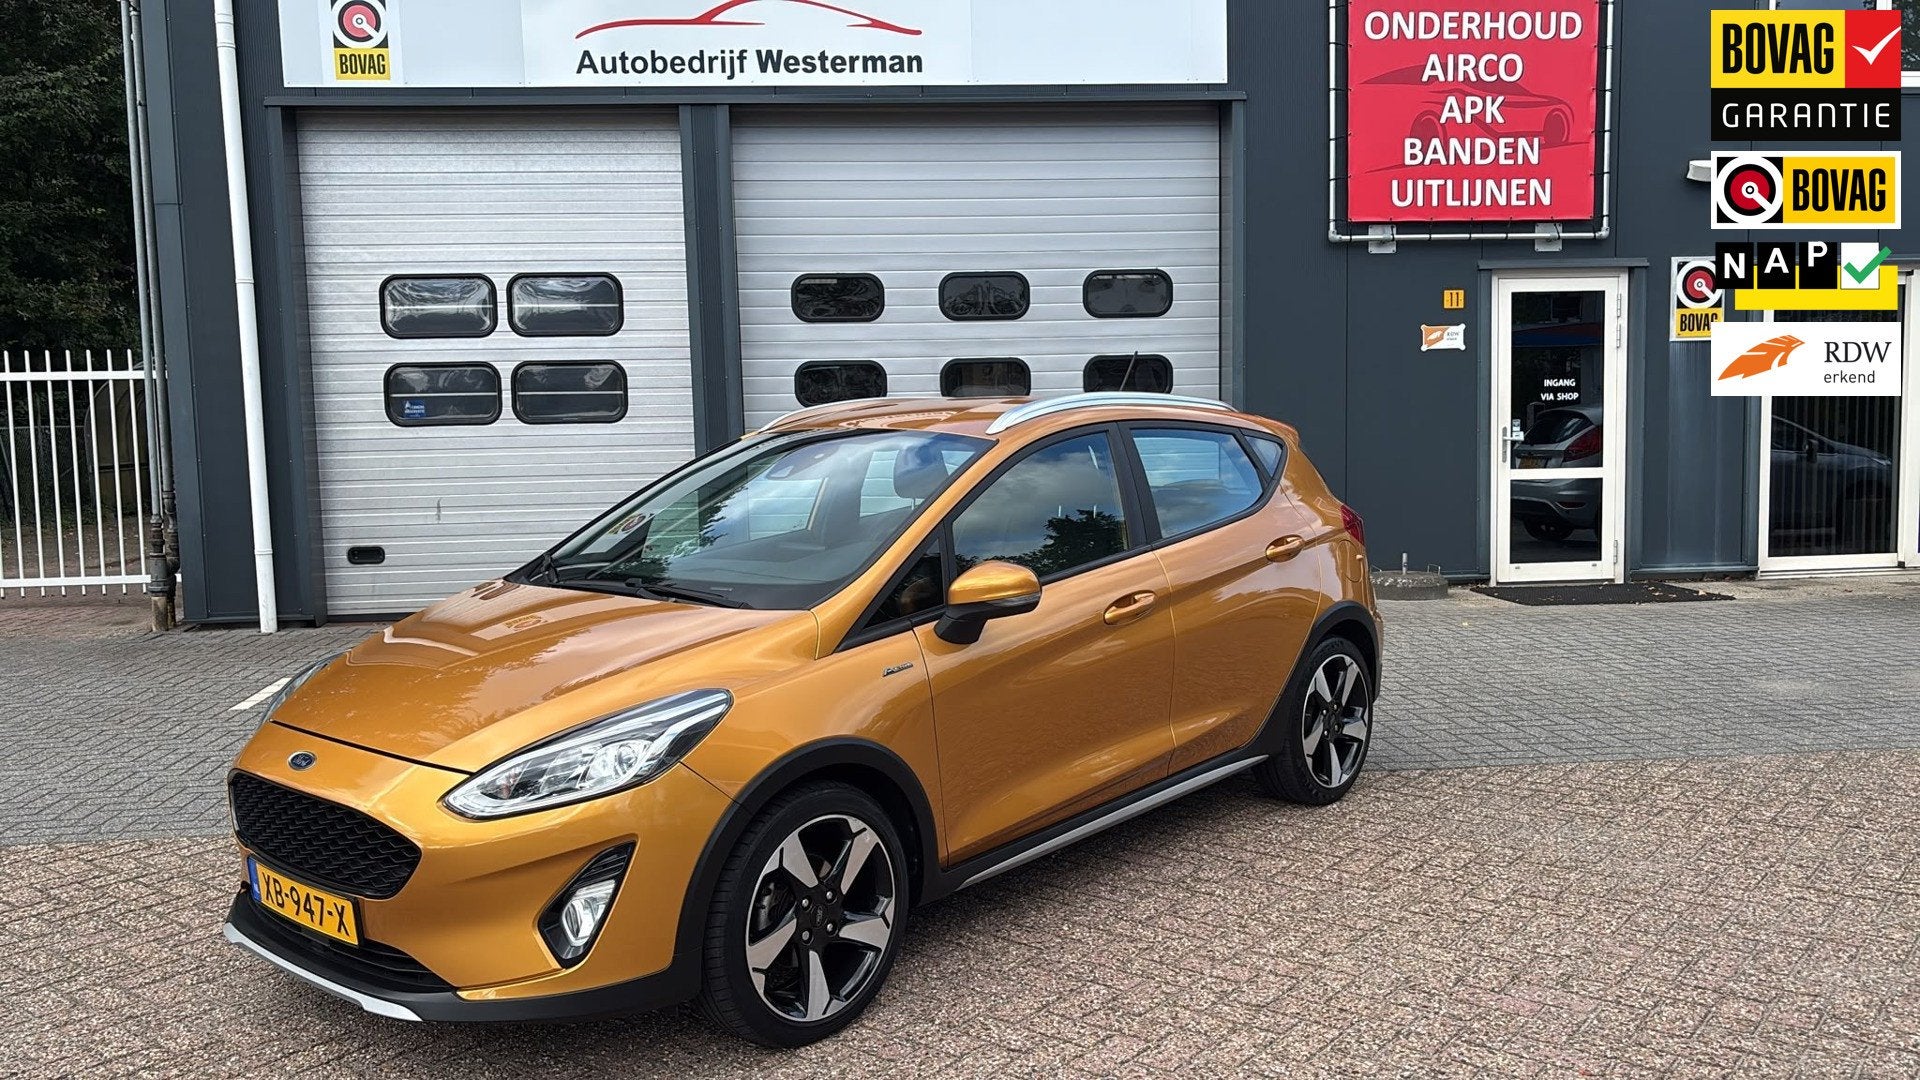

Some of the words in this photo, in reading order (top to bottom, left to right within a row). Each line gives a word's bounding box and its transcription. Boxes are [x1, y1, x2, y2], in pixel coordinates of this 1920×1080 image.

[1364, 11, 1583, 40] ONDERHOUD
[339, 53, 386, 75] BOVAG
[576, 49, 748, 80] Autobedrijf
[756, 49, 923, 74] Westerman
[1421, 53, 1524, 82] AIRCO
[1439, 96, 1505, 124] APK
[1404, 137, 1540, 165] BANDEN
[1391, 178, 1551, 207] UITLIJNEN
[1450, 291, 1459, 307] 11
[1540, 393, 1554, 401] VIA
[1557, 393, 1579, 401] SHOP
[1544, 379, 1576, 387] INGANG
[262, 872, 350, 936] XB-947-X
